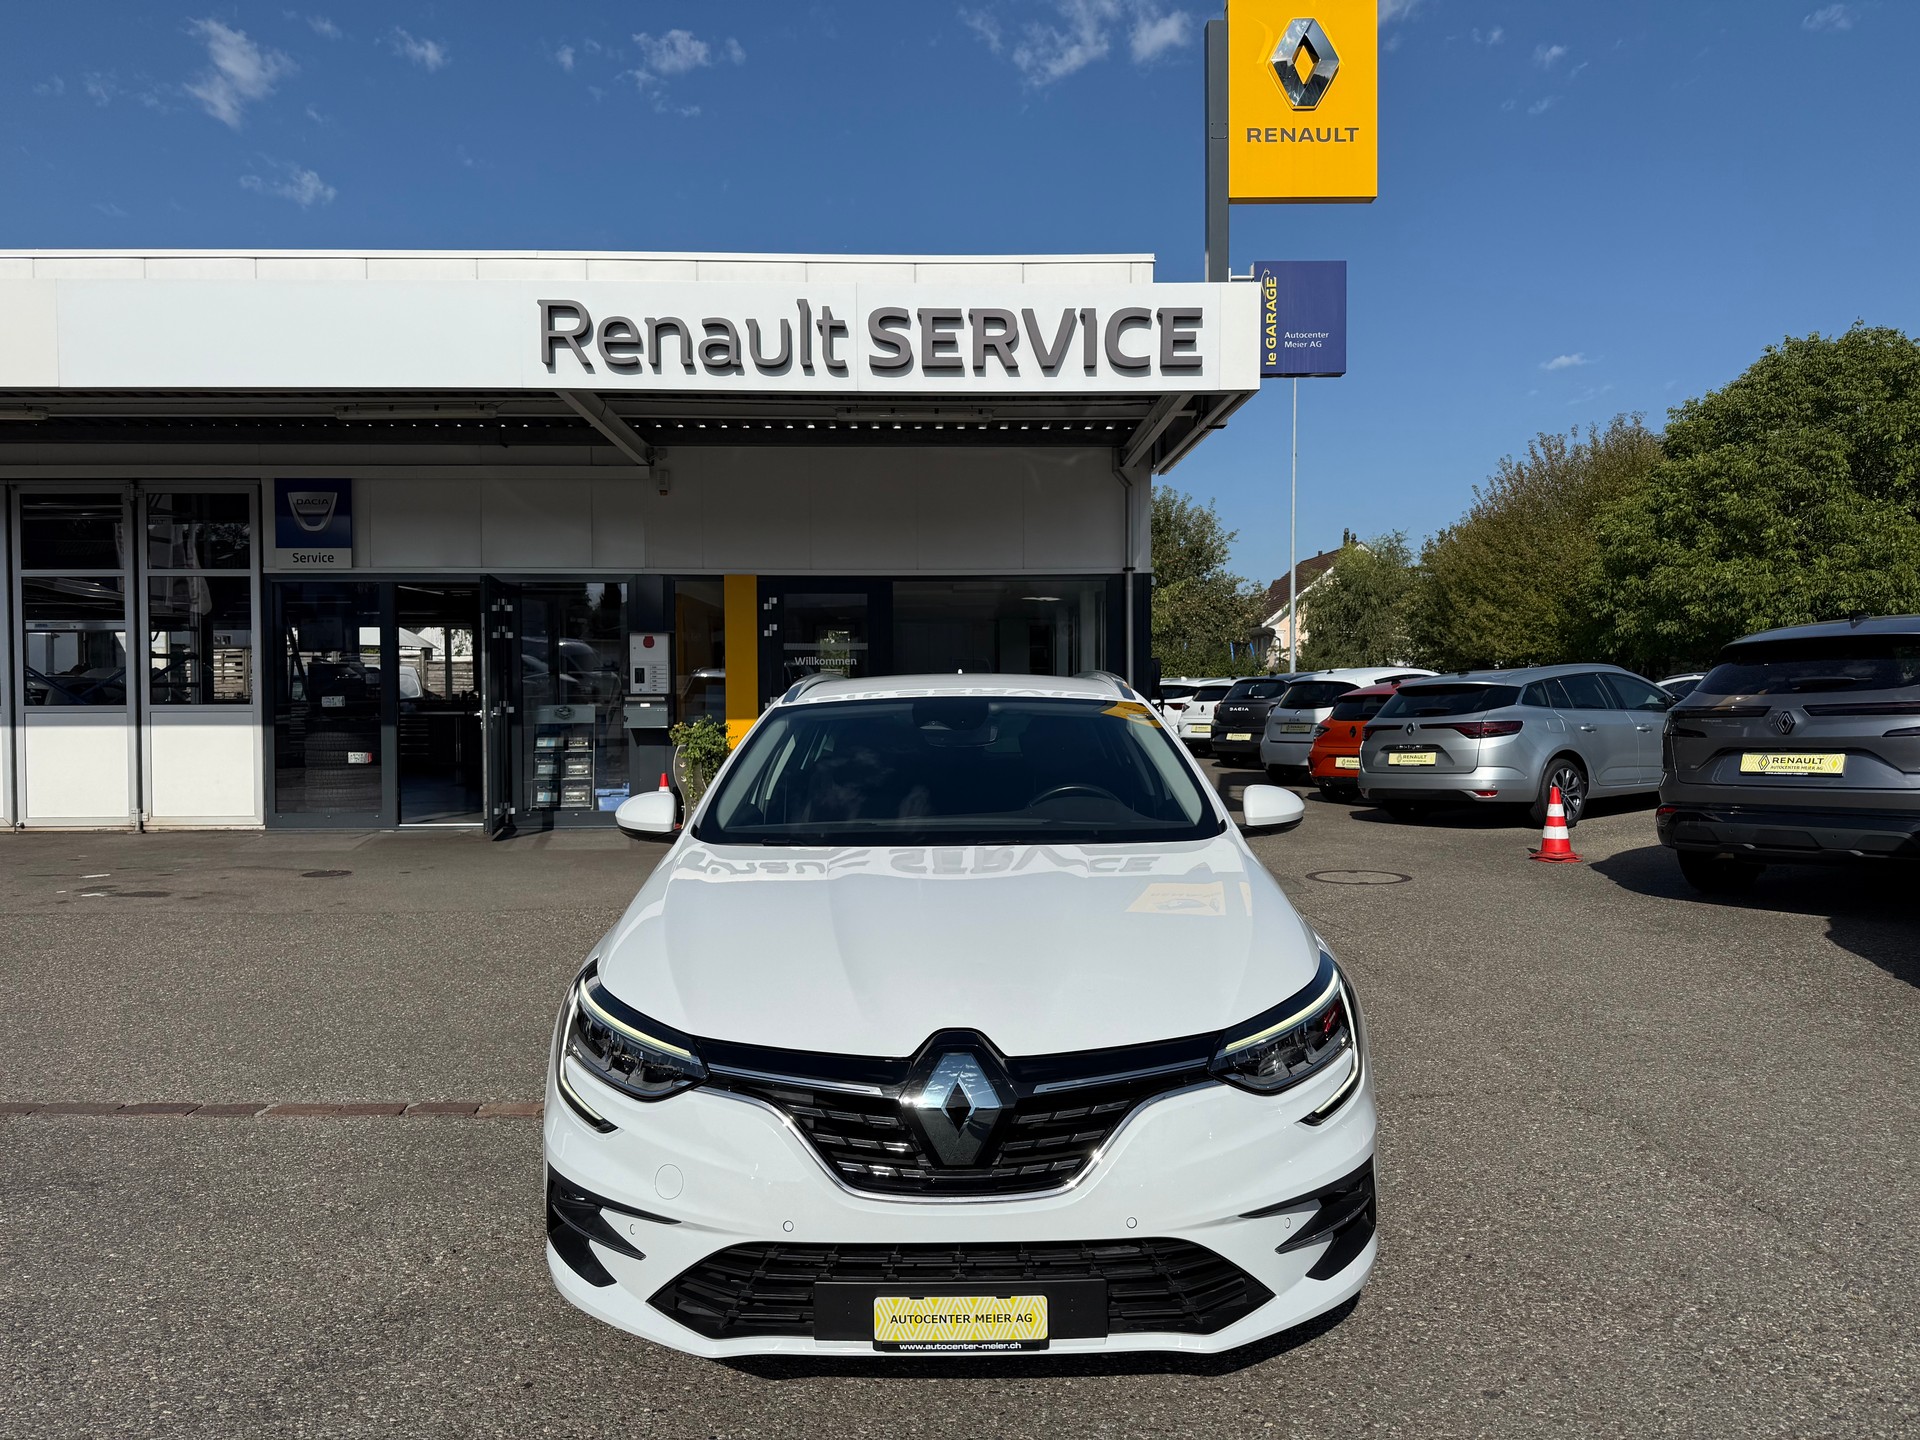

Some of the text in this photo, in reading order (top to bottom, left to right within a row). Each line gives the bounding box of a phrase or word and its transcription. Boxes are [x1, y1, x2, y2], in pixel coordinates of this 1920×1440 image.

[1246, 127, 1360, 143] RENAULT
[1265, 276, 1277, 366] le GARAGE
[537, 298, 1203, 371] Renault SERVICE
[1284, 331, 1330, 339] Autocenter
[1284, 340, 1323, 349] Meier AG
[292, 552, 335, 563] Service
[794, 656, 857, 666] Willkommen
[1772, 757, 1825, 765] RENAULT
[890, 1313, 1033, 1324] AUTOCENTER MEIER AG
[899, 1342, 1022, 1351] www.autocenter-meier.ch
